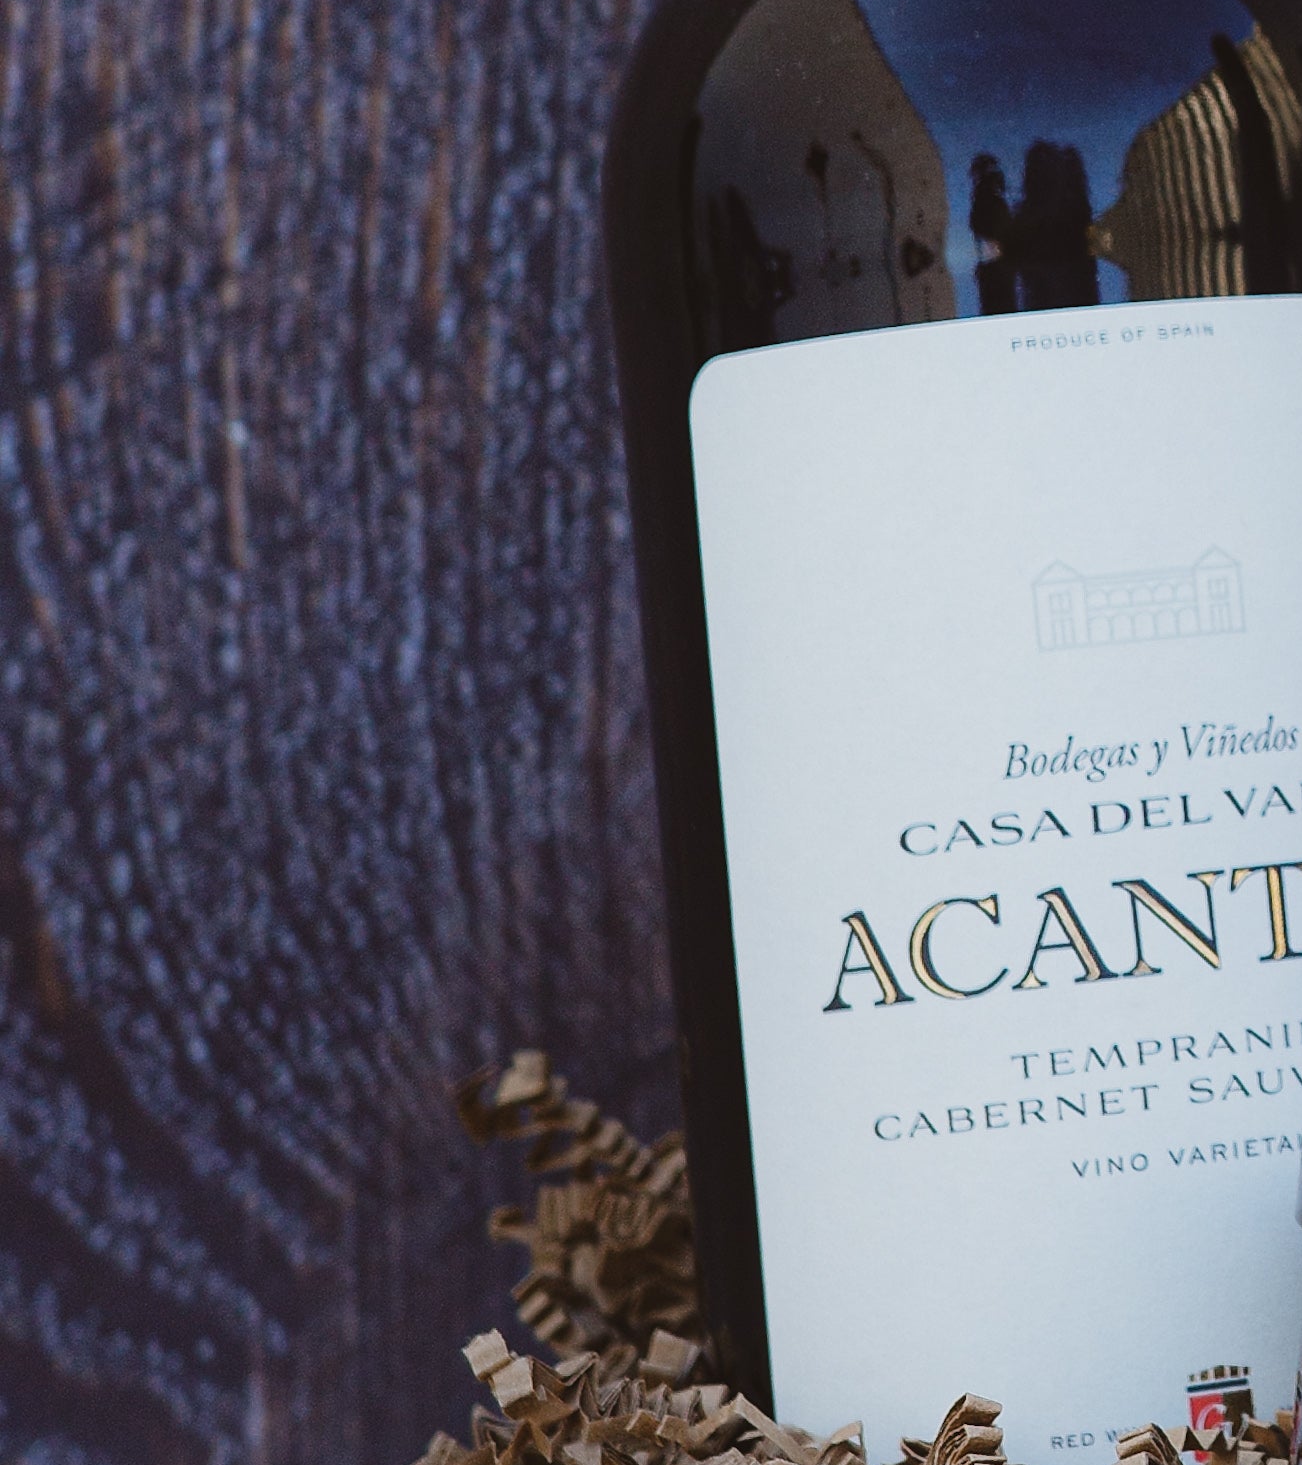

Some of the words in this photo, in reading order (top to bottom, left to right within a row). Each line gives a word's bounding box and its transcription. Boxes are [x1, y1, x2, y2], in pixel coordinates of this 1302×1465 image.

[1011, 329, 1111, 352] PRODUCE
[1121, 327, 1147, 343] OF
[1157, 323, 1216, 341] SPAIN
[1003, 734, 1139, 783] Bodegas
[1147, 740, 1169, 777] y
[1179, 715, 1299, 759] Viñedos
[900, 808, 1072, 856] CASA
[1091, 793, 1213, 835] DEL
[873, 1084, 1162, 1143] CABERNET
[1072, 1152, 1150, 1179] VINO
[1051, 1432, 1095, 1450] RED
